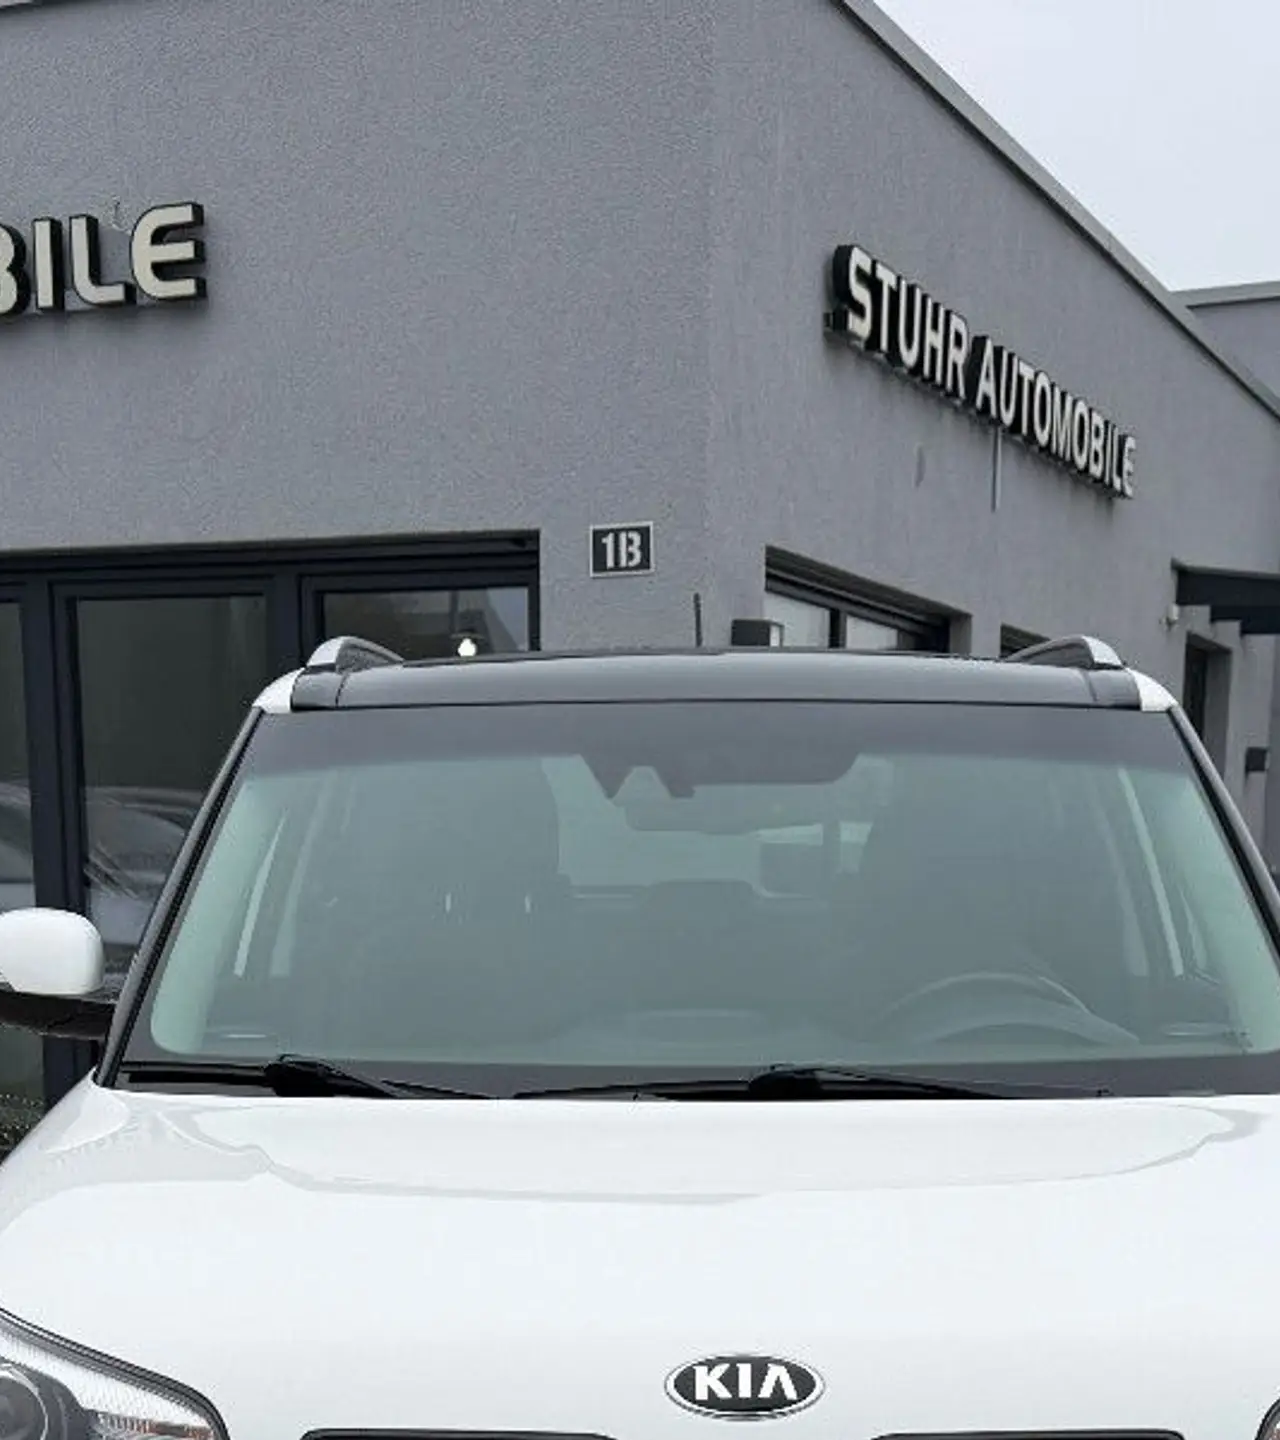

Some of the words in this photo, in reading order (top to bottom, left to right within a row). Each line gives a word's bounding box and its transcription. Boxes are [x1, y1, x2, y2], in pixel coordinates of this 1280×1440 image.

[834, 245, 969, 402] STUHR
[974, 335, 1137, 499] AUTOMOBILE
[600, 530, 643, 570] 1B
[692, 1362, 799, 1401] KIA
